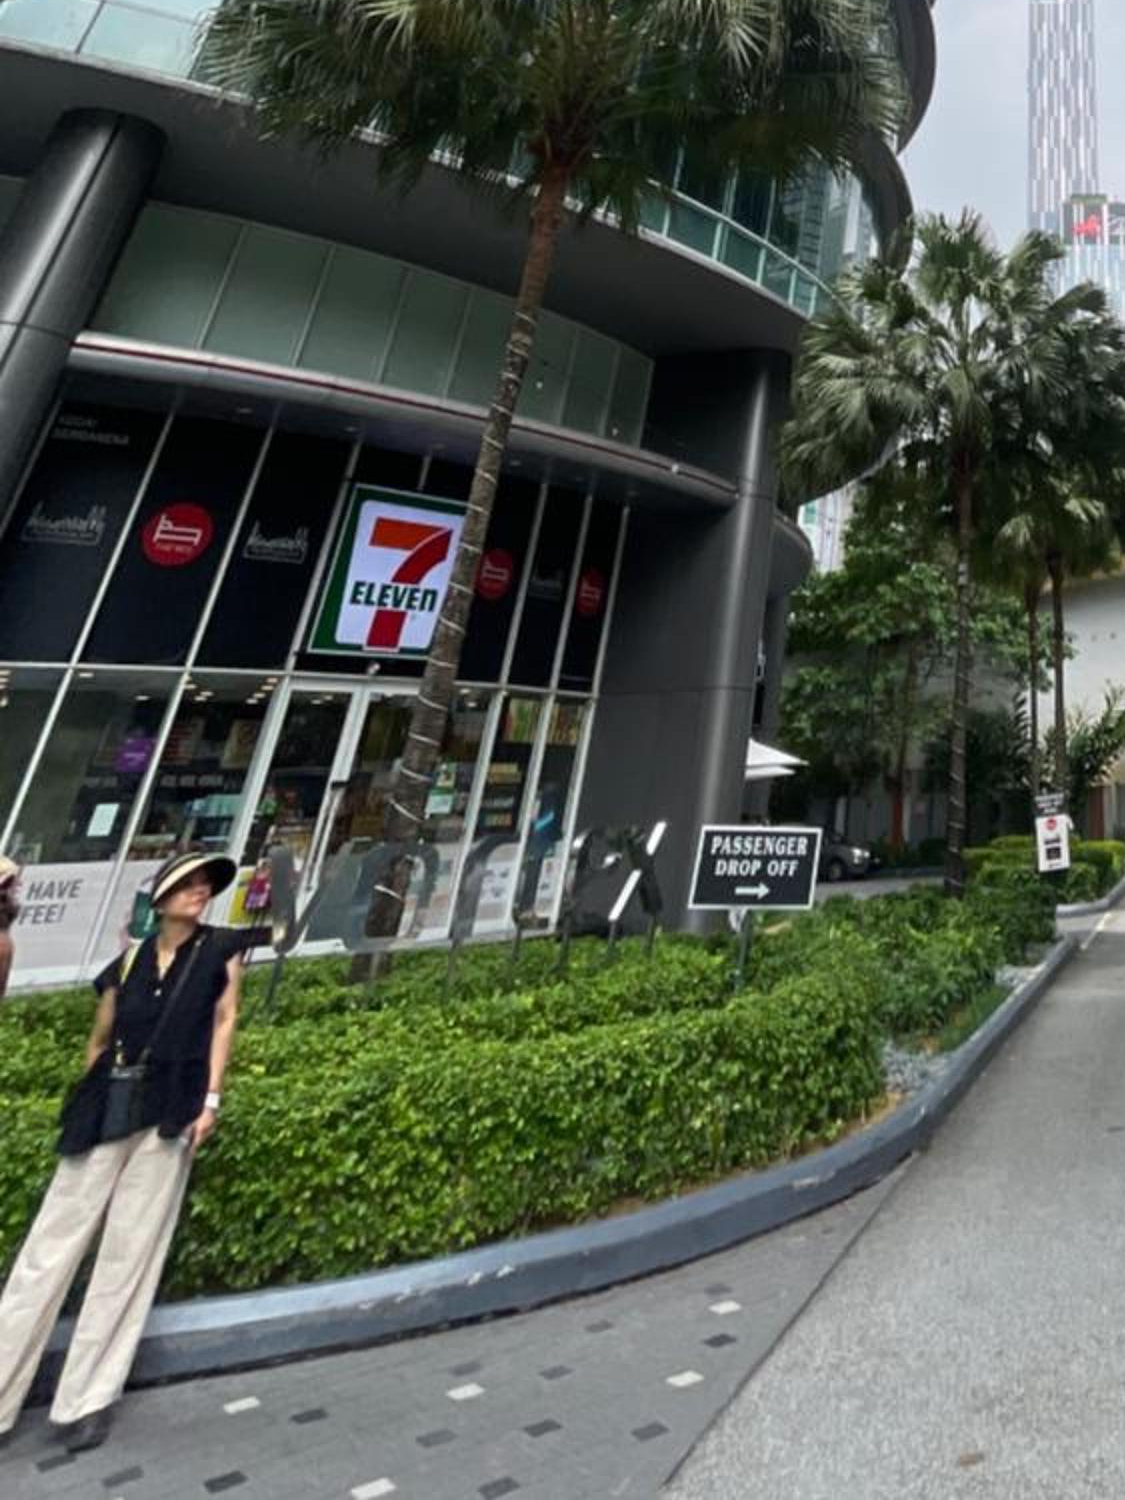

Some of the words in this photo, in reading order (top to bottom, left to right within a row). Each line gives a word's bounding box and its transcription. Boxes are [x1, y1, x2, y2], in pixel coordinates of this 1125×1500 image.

[363, 516, 454, 650] 7
[710, 835, 808, 856] PASSENGER
[715, 859, 762, 877] DROP
[767, 859, 799, 877] OFF
[26, 879, 84, 901] HAVE
[18, 903, 66, 926] FEE!
